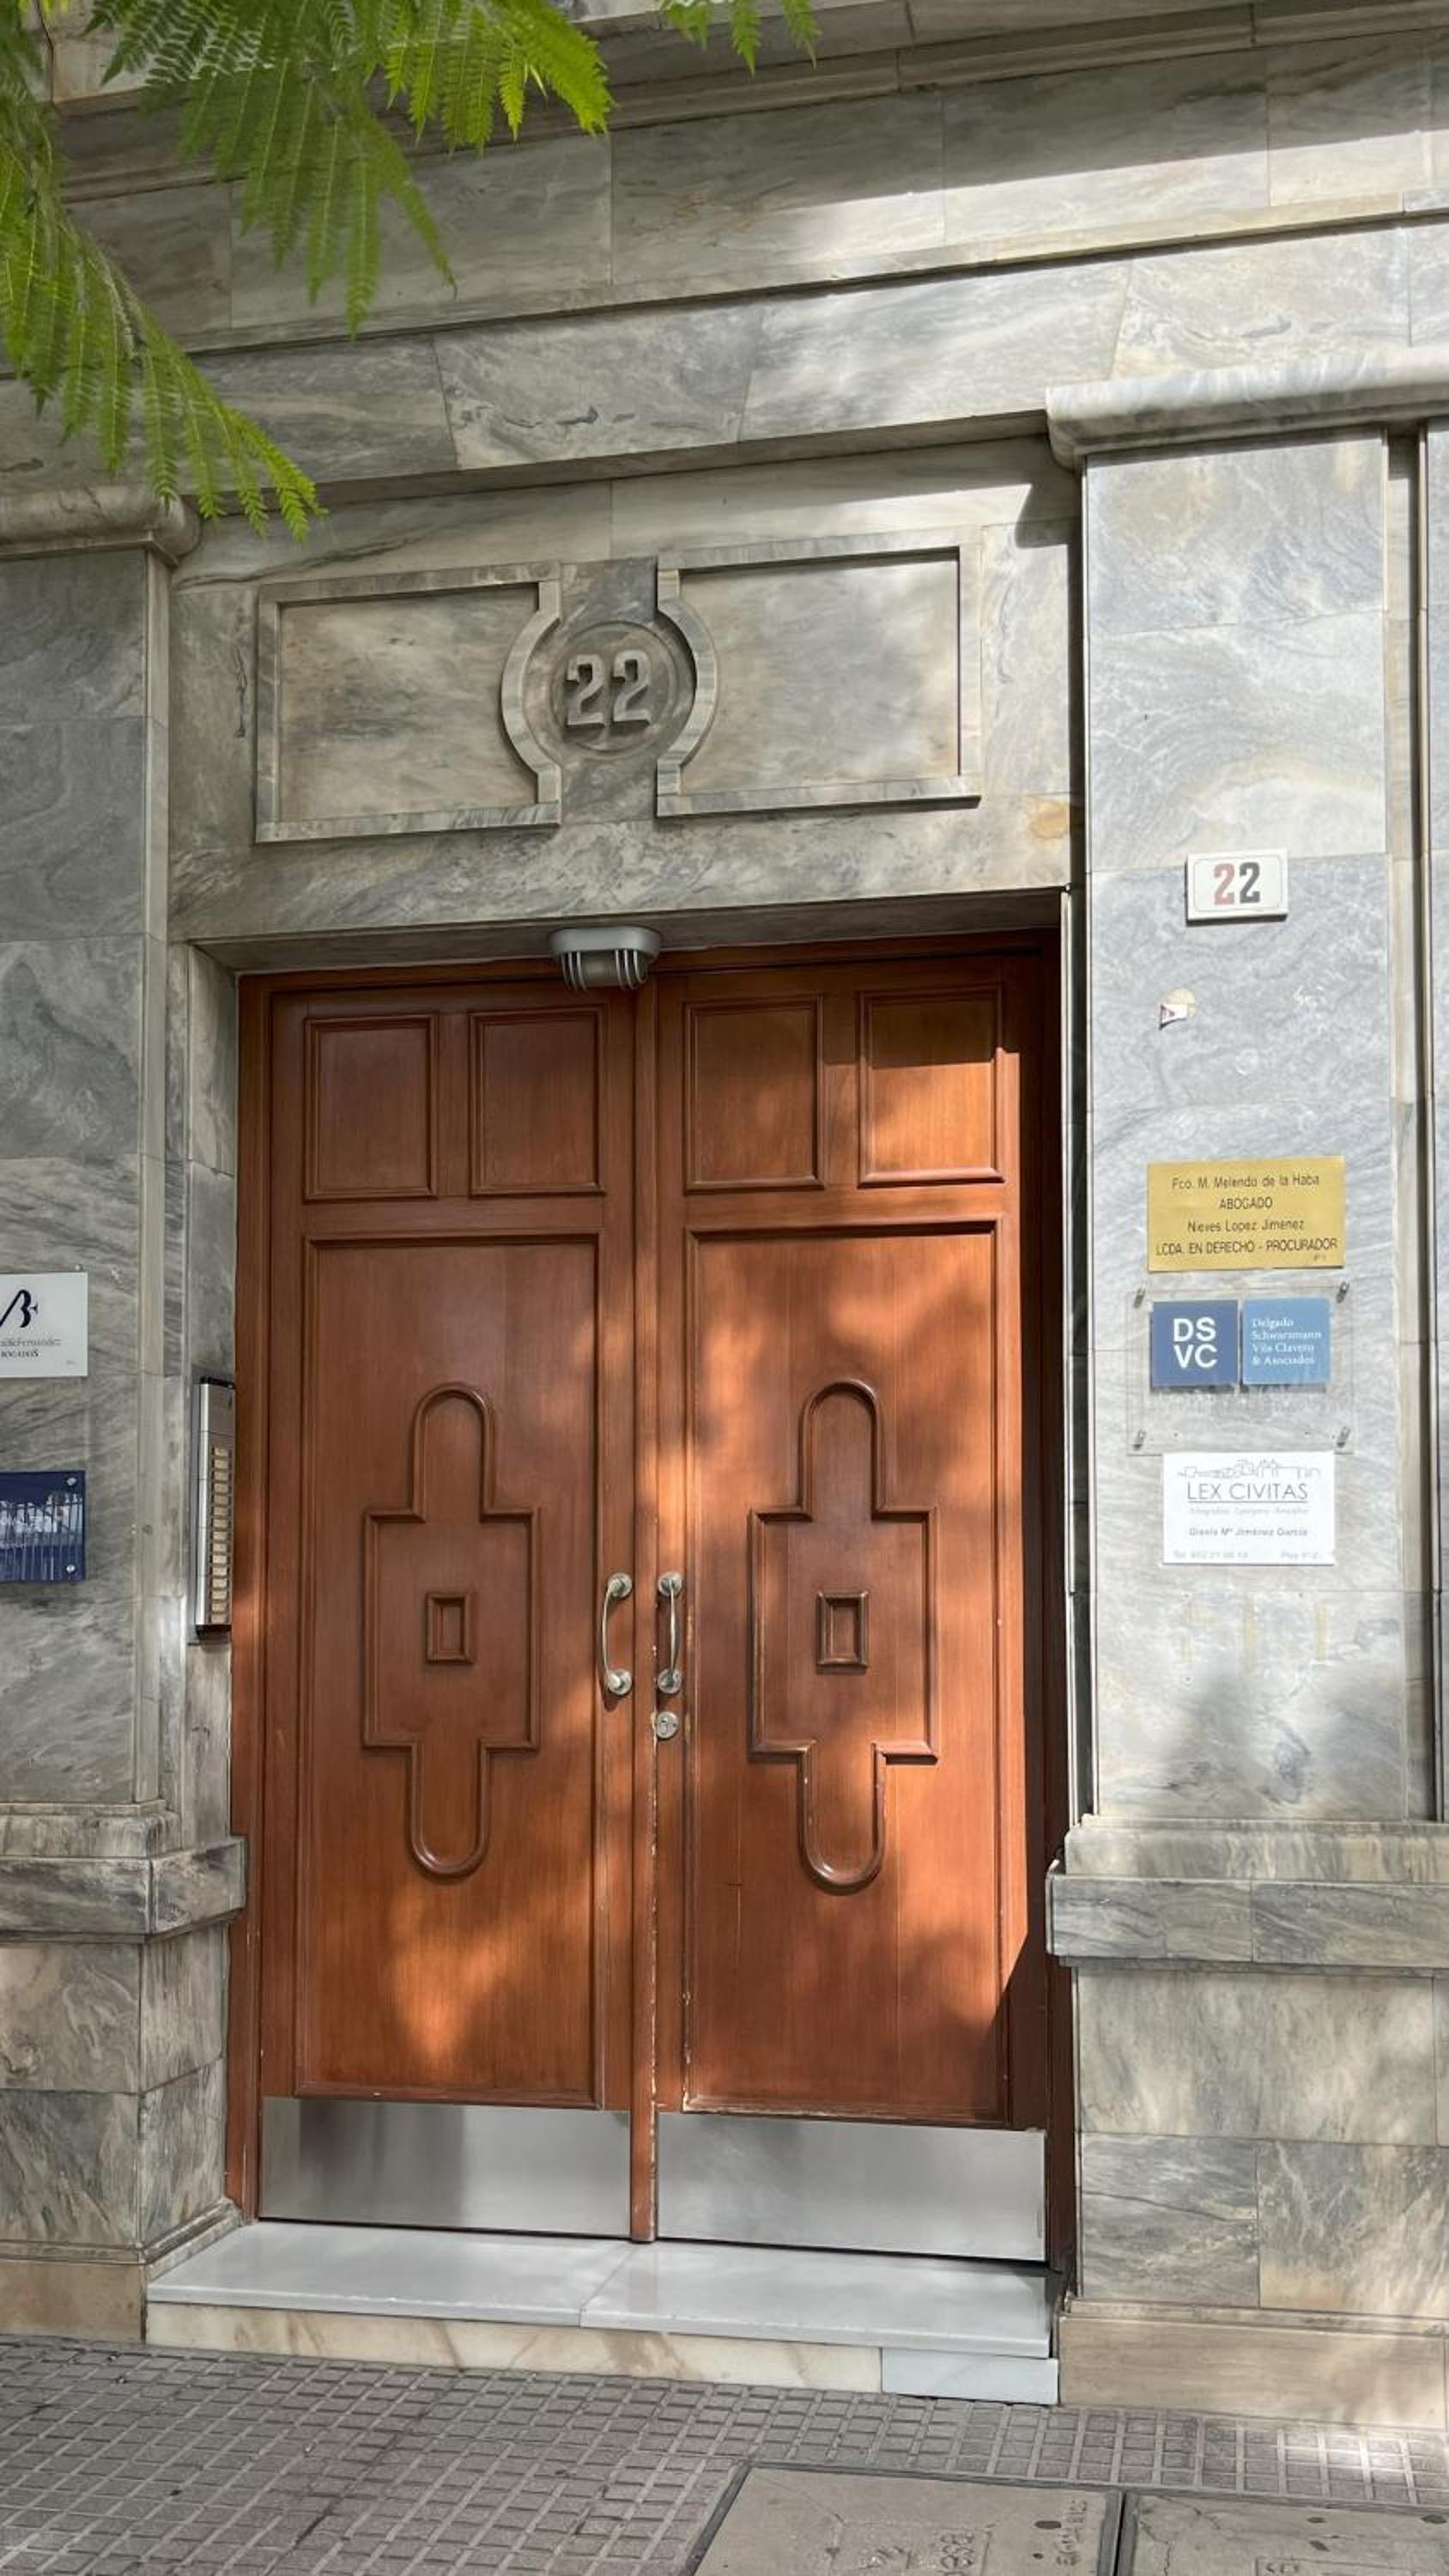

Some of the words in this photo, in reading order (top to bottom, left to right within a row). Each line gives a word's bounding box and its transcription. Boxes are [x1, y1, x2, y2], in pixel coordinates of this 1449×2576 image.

[564, 648, 652, 728] 22
[1213, 861, 1261, 906] 22
[1213, 1174, 1258, 1188] Melendo
[1262, 1174, 1275, 1187] de
[1278, 1174, 1289, 1186] la
[1292, 1172, 1319, 1186] Haba
[1219, 1196, 1273, 1211] ABOGADO
[1187, 1219, 1222, 1233] Nieves
[1188, 1241, 1203, 1255] EN
[1206, 1239, 1255, 1255] DERECHO
[1265, 1236, 1338, 1252] PROCURADOR
[1173, 1316, 1216, 1343] DS
[1252, 1317, 1294, 1329] Delgado
[1173, 1344, 1218, 1370] VC
[1264, 1353, 1317, 1366] Asociados
[1186, 1481, 1222, 1500] LEX
[1228, 1482, 1309, 1500] CIVITAS
